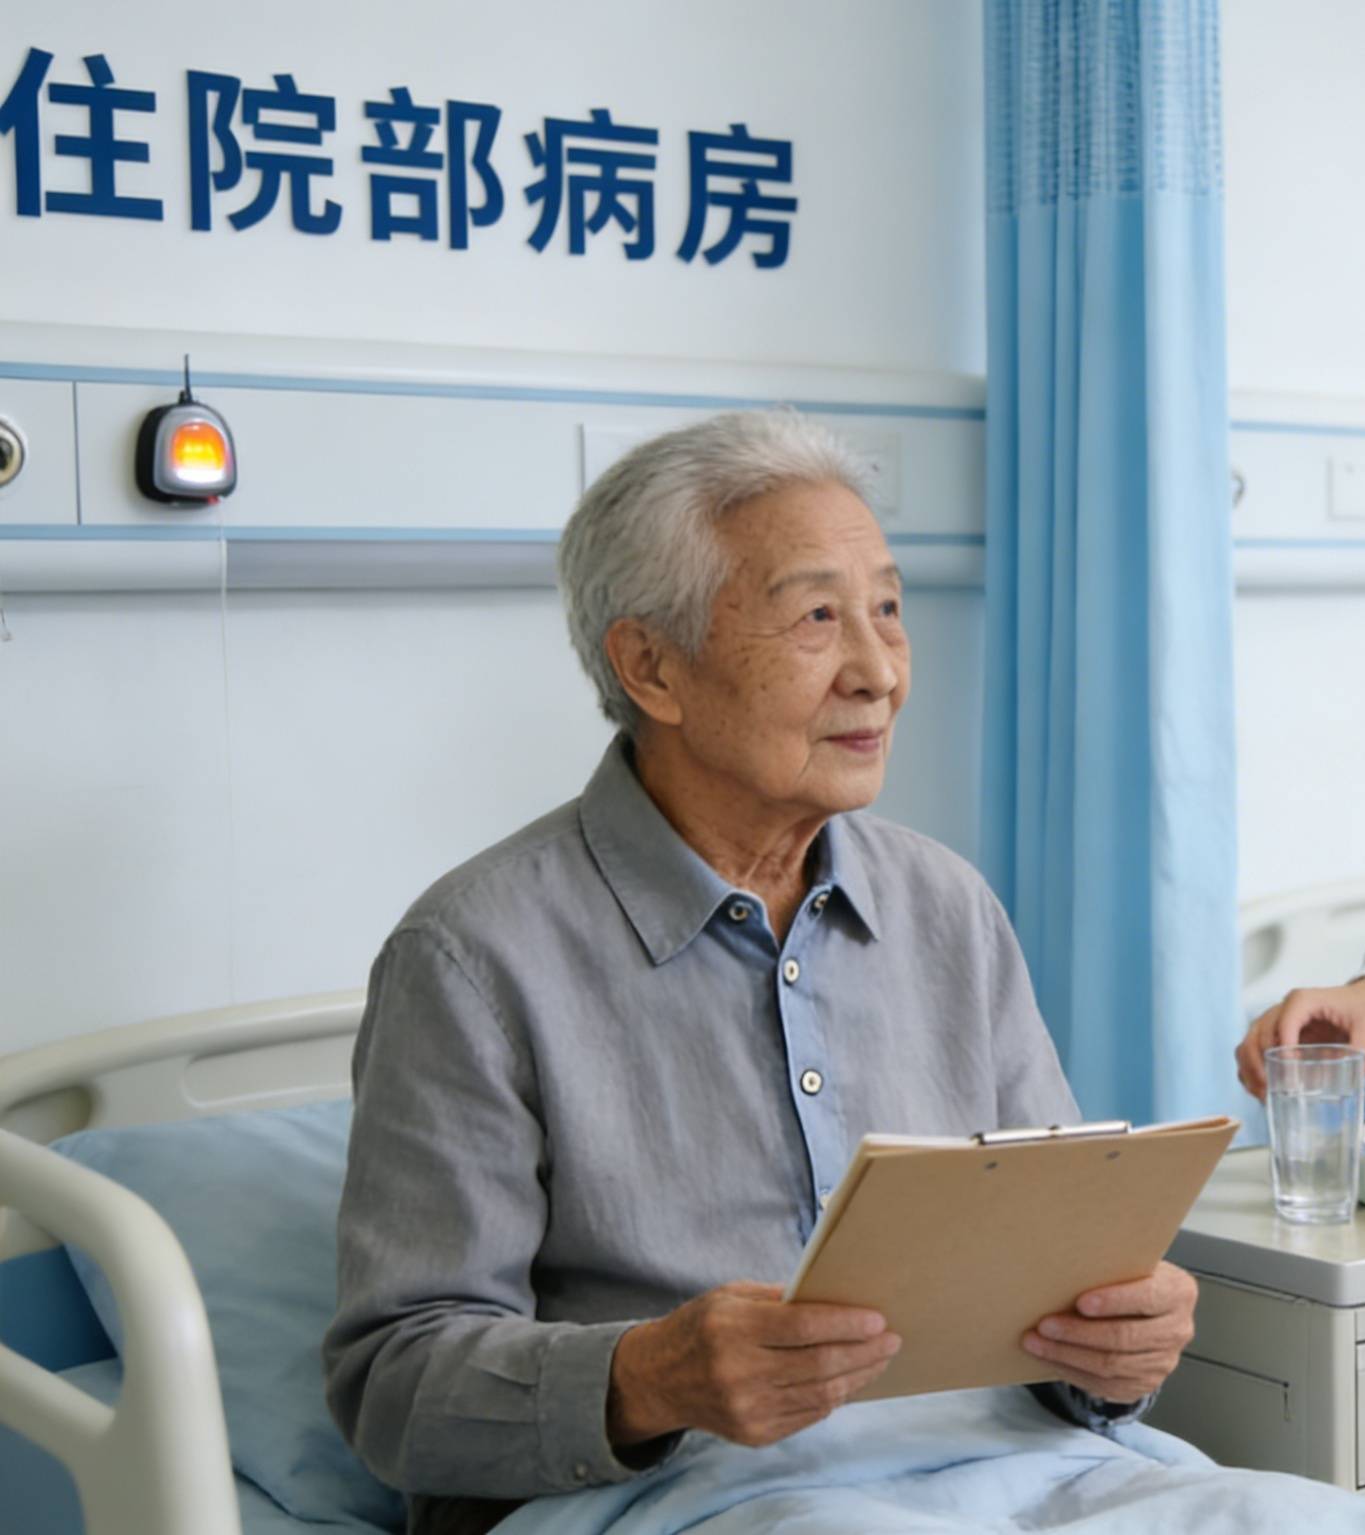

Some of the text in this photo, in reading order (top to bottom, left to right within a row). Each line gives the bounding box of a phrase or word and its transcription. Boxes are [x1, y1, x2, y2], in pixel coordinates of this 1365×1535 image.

[0, 47, 799, 269] 住院部病房
